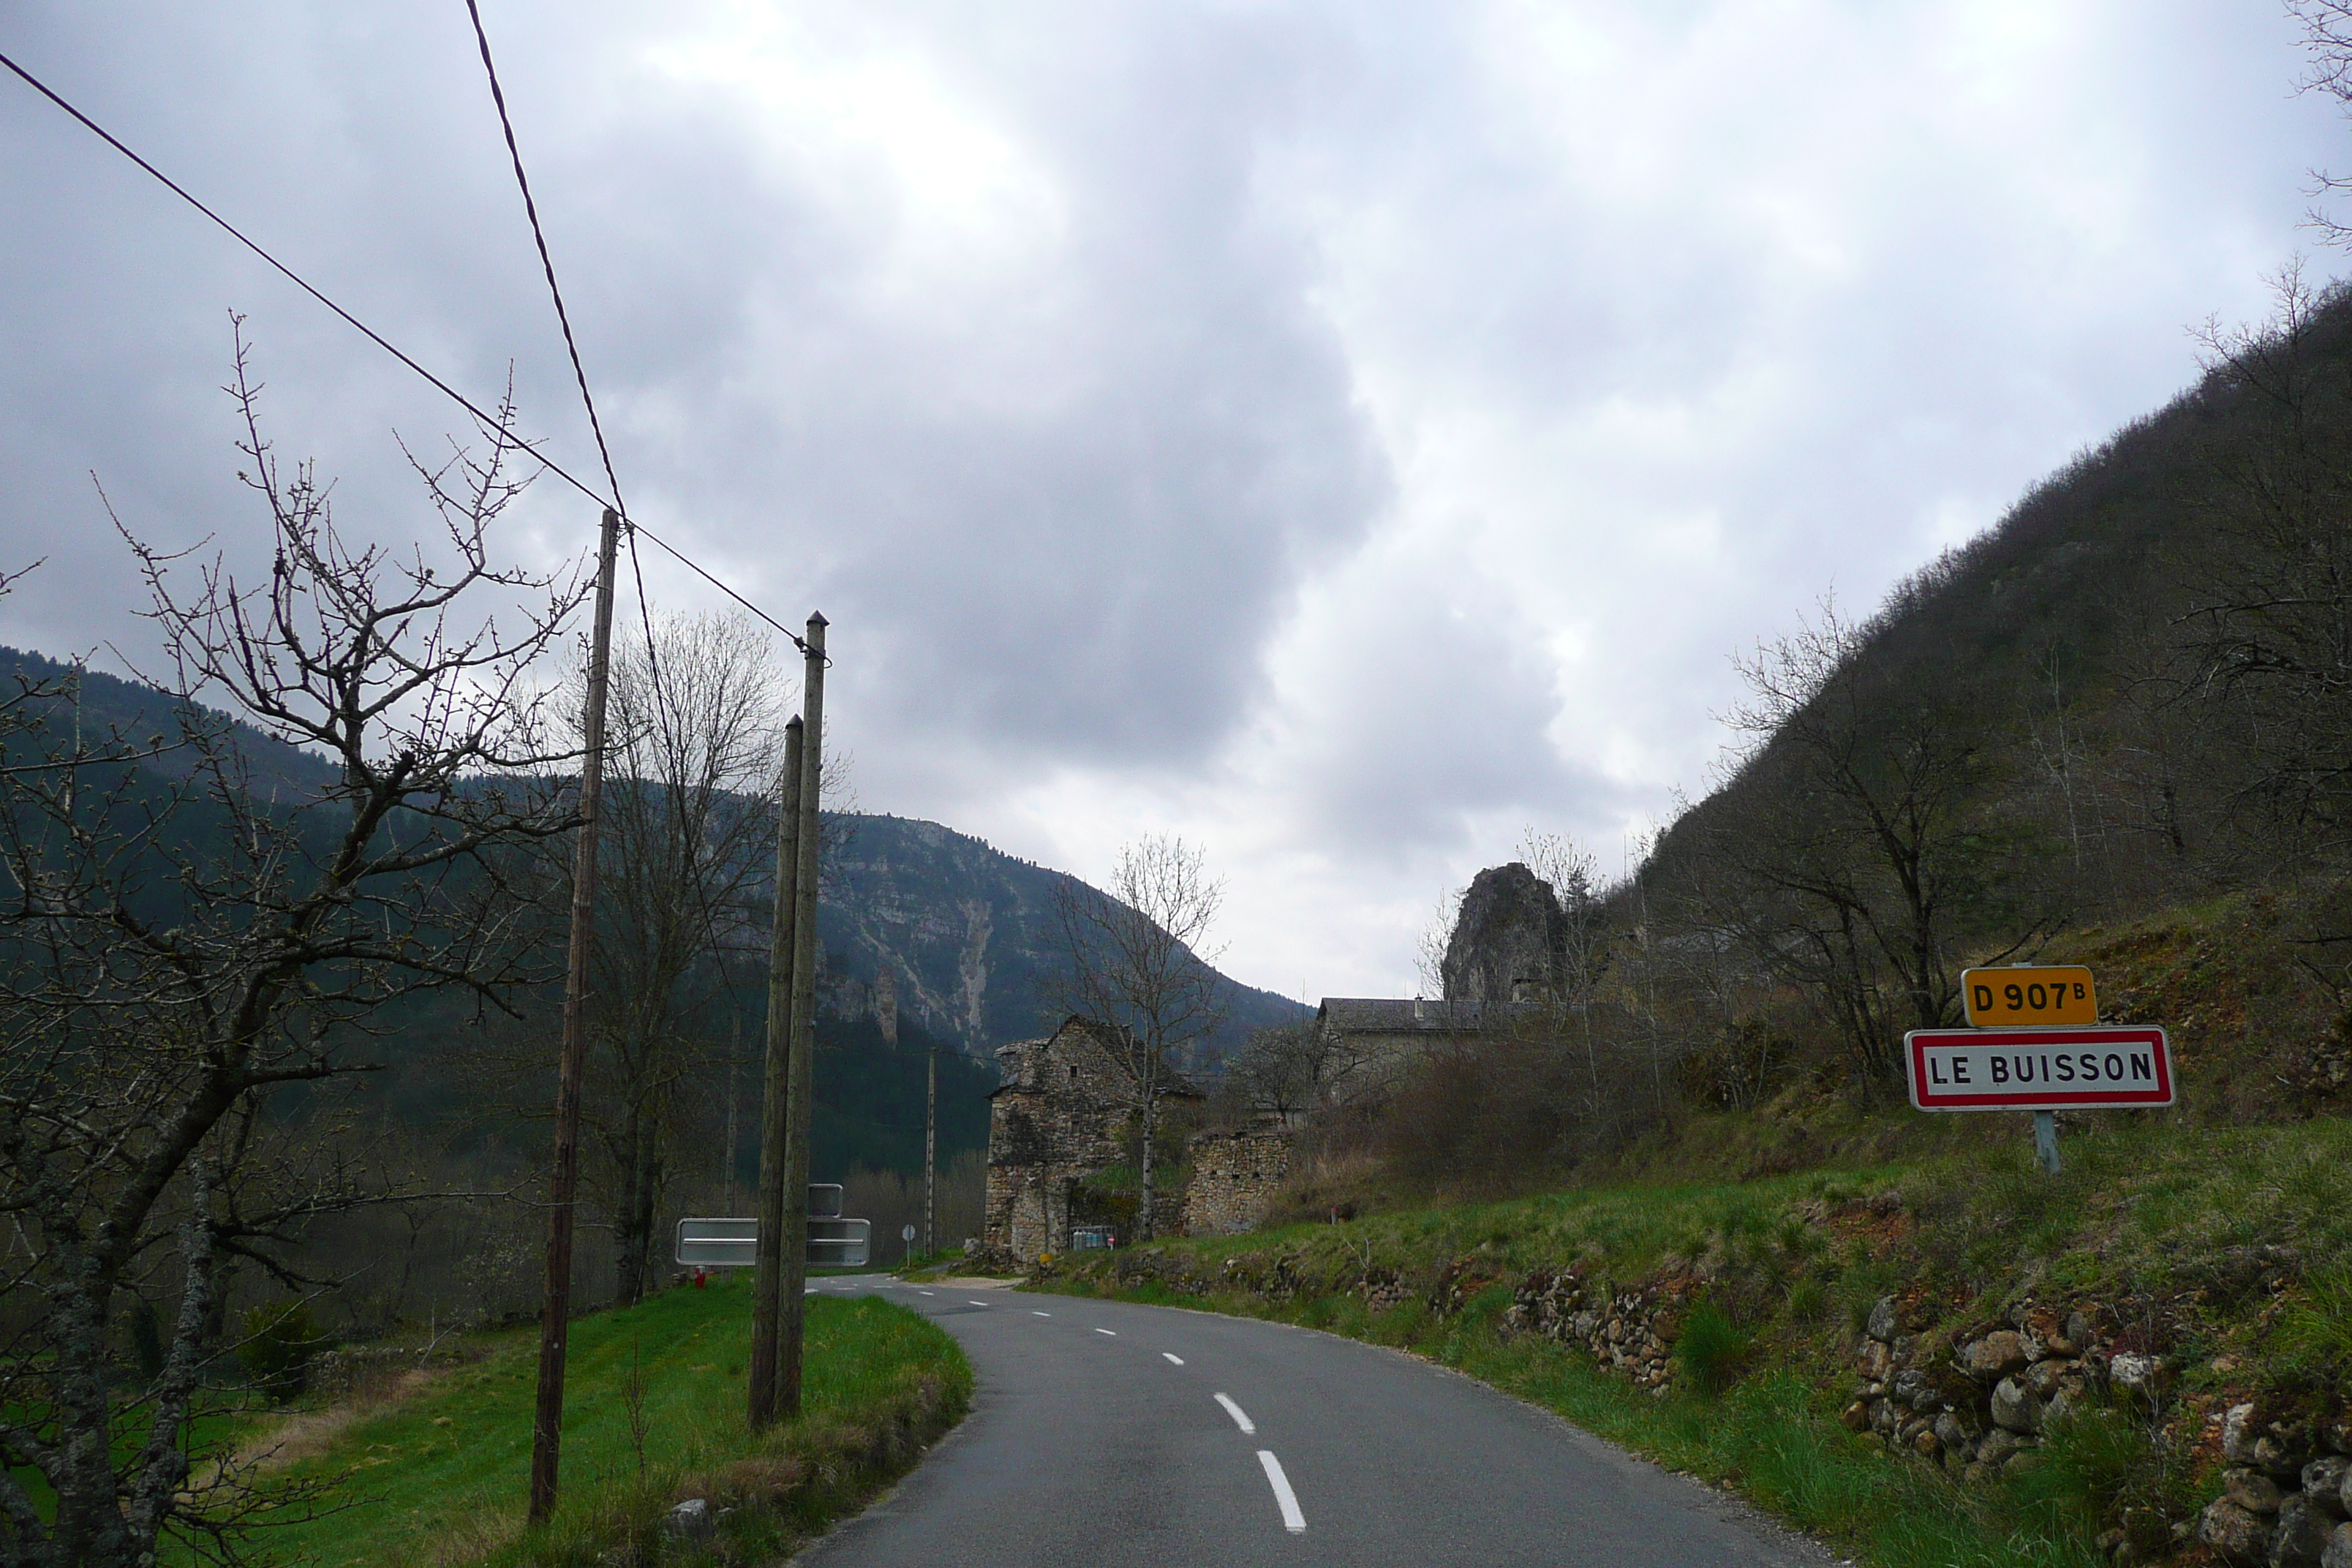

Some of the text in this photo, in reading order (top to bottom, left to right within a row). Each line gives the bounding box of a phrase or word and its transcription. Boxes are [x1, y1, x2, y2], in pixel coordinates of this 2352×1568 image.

[1975, 984, 1993, 1011] D
[1931, 1053, 2152, 1084] LE BUISSON
